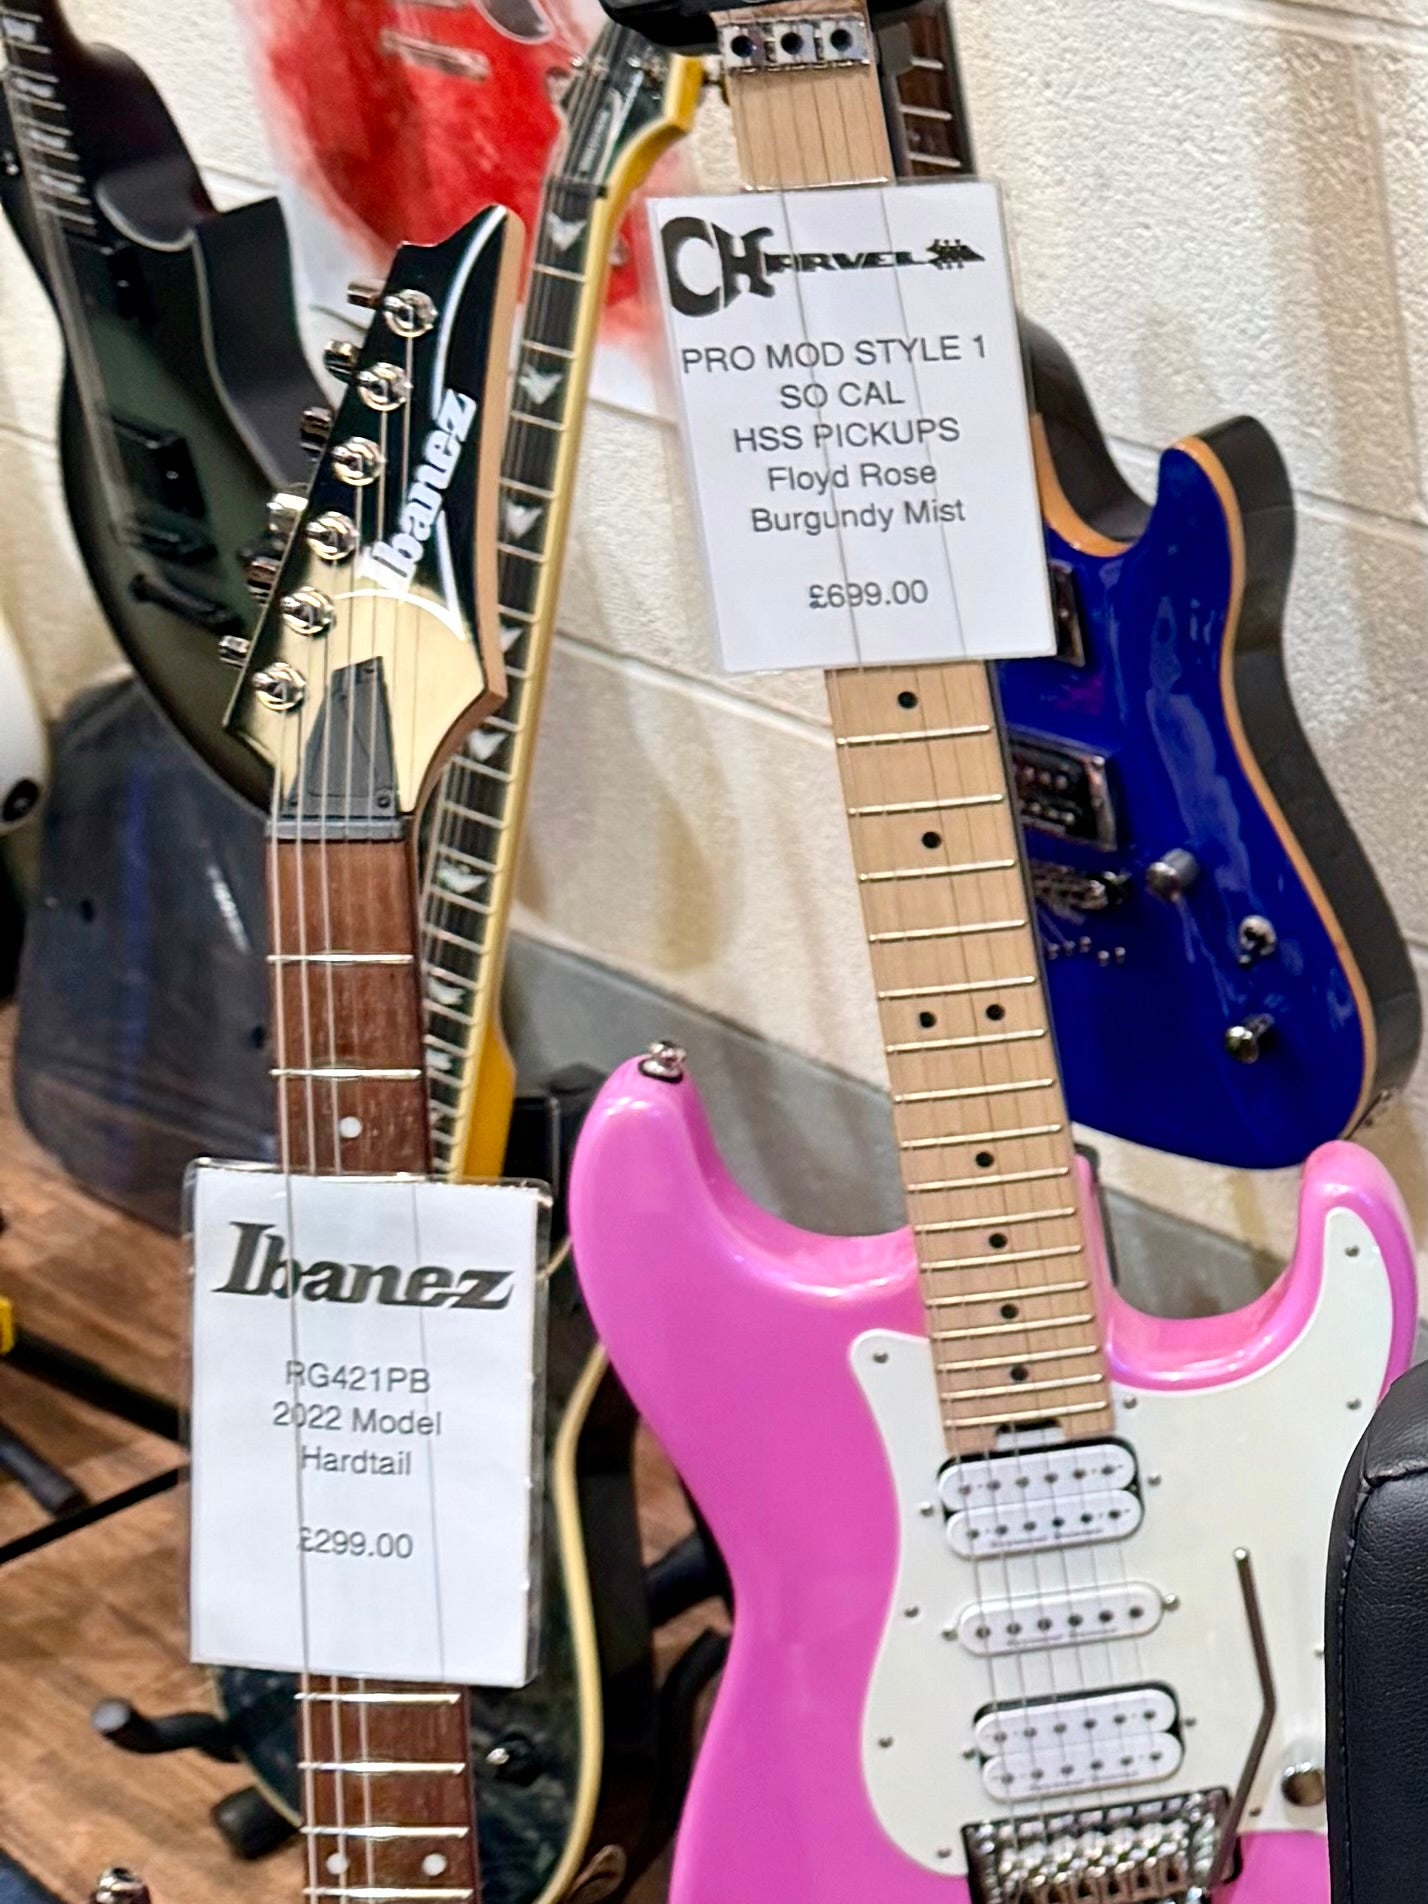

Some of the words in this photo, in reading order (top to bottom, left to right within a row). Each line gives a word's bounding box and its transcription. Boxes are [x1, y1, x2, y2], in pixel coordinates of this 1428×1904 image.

[681, 346, 754, 374] PRO
[767, 341, 845, 369] MOD
[855, 335, 962, 366] STYLE
[973, 335, 986, 358] 1
[780, 383, 827, 410] SO
[839, 381, 905, 407] CAL
[733, 426, 802, 453] HSS
[814, 417, 960, 448] PICKUPS
[358, 388, 476, 593] Ibanez
[768, 465, 849, 496] Floyd
[861, 462, 937, 486] Rose
[751, 503, 894, 535] Burgundy
[905, 499, 966, 525] Mist
[809, 579, 928, 609] £699.00
[212, 1221, 515, 1310] Ibanez
[286, 1361, 431, 1394] RG421PB
[272, 1401, 342, 1430] 2022
[353, 1406, 442, 1436] Model
[301, 1445, 411, 1476] Hardtail
[298, 1526, 414, 1559] £299.00
